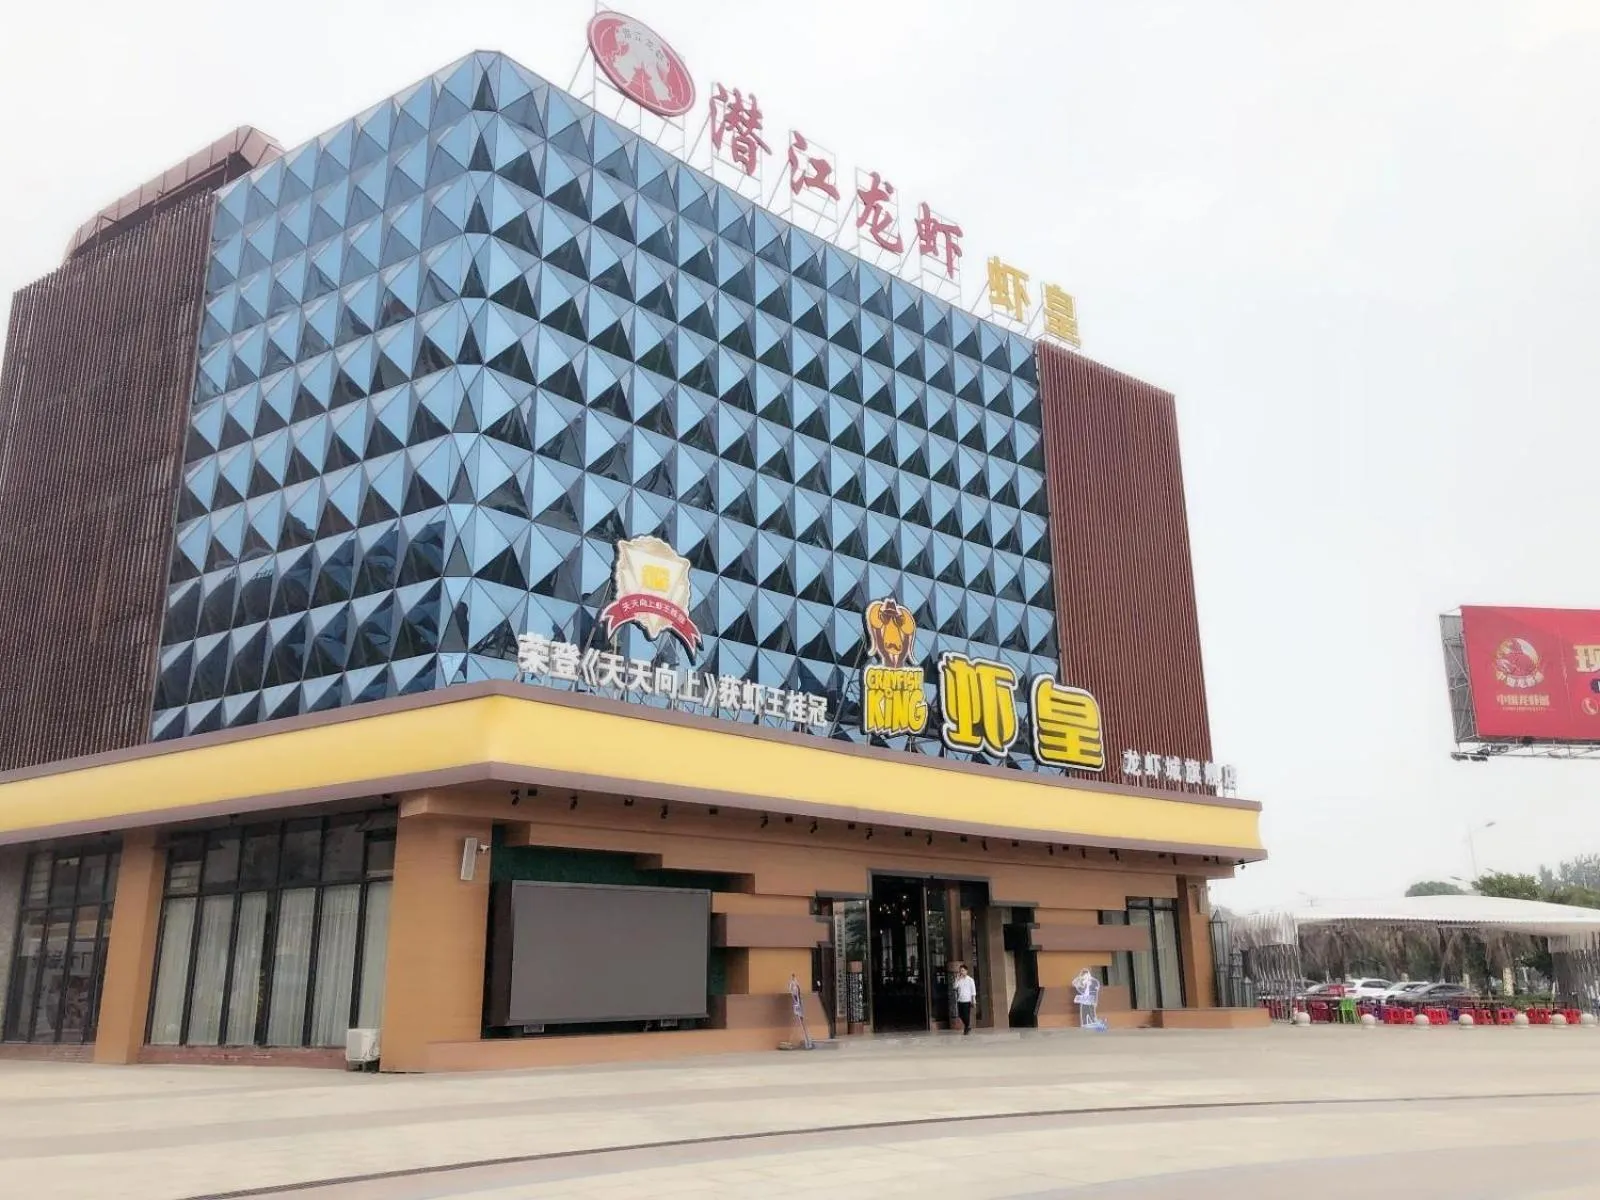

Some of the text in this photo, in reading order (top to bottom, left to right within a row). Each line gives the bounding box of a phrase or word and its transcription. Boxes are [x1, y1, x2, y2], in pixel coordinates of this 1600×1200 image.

[709, 82, 1081, 348] 潜江龙虾 虾皇
[518, 632, 829, 727] 荣登《天天向上》获虾王桂冠
[941, 654, 1103, 769] 虾皇
